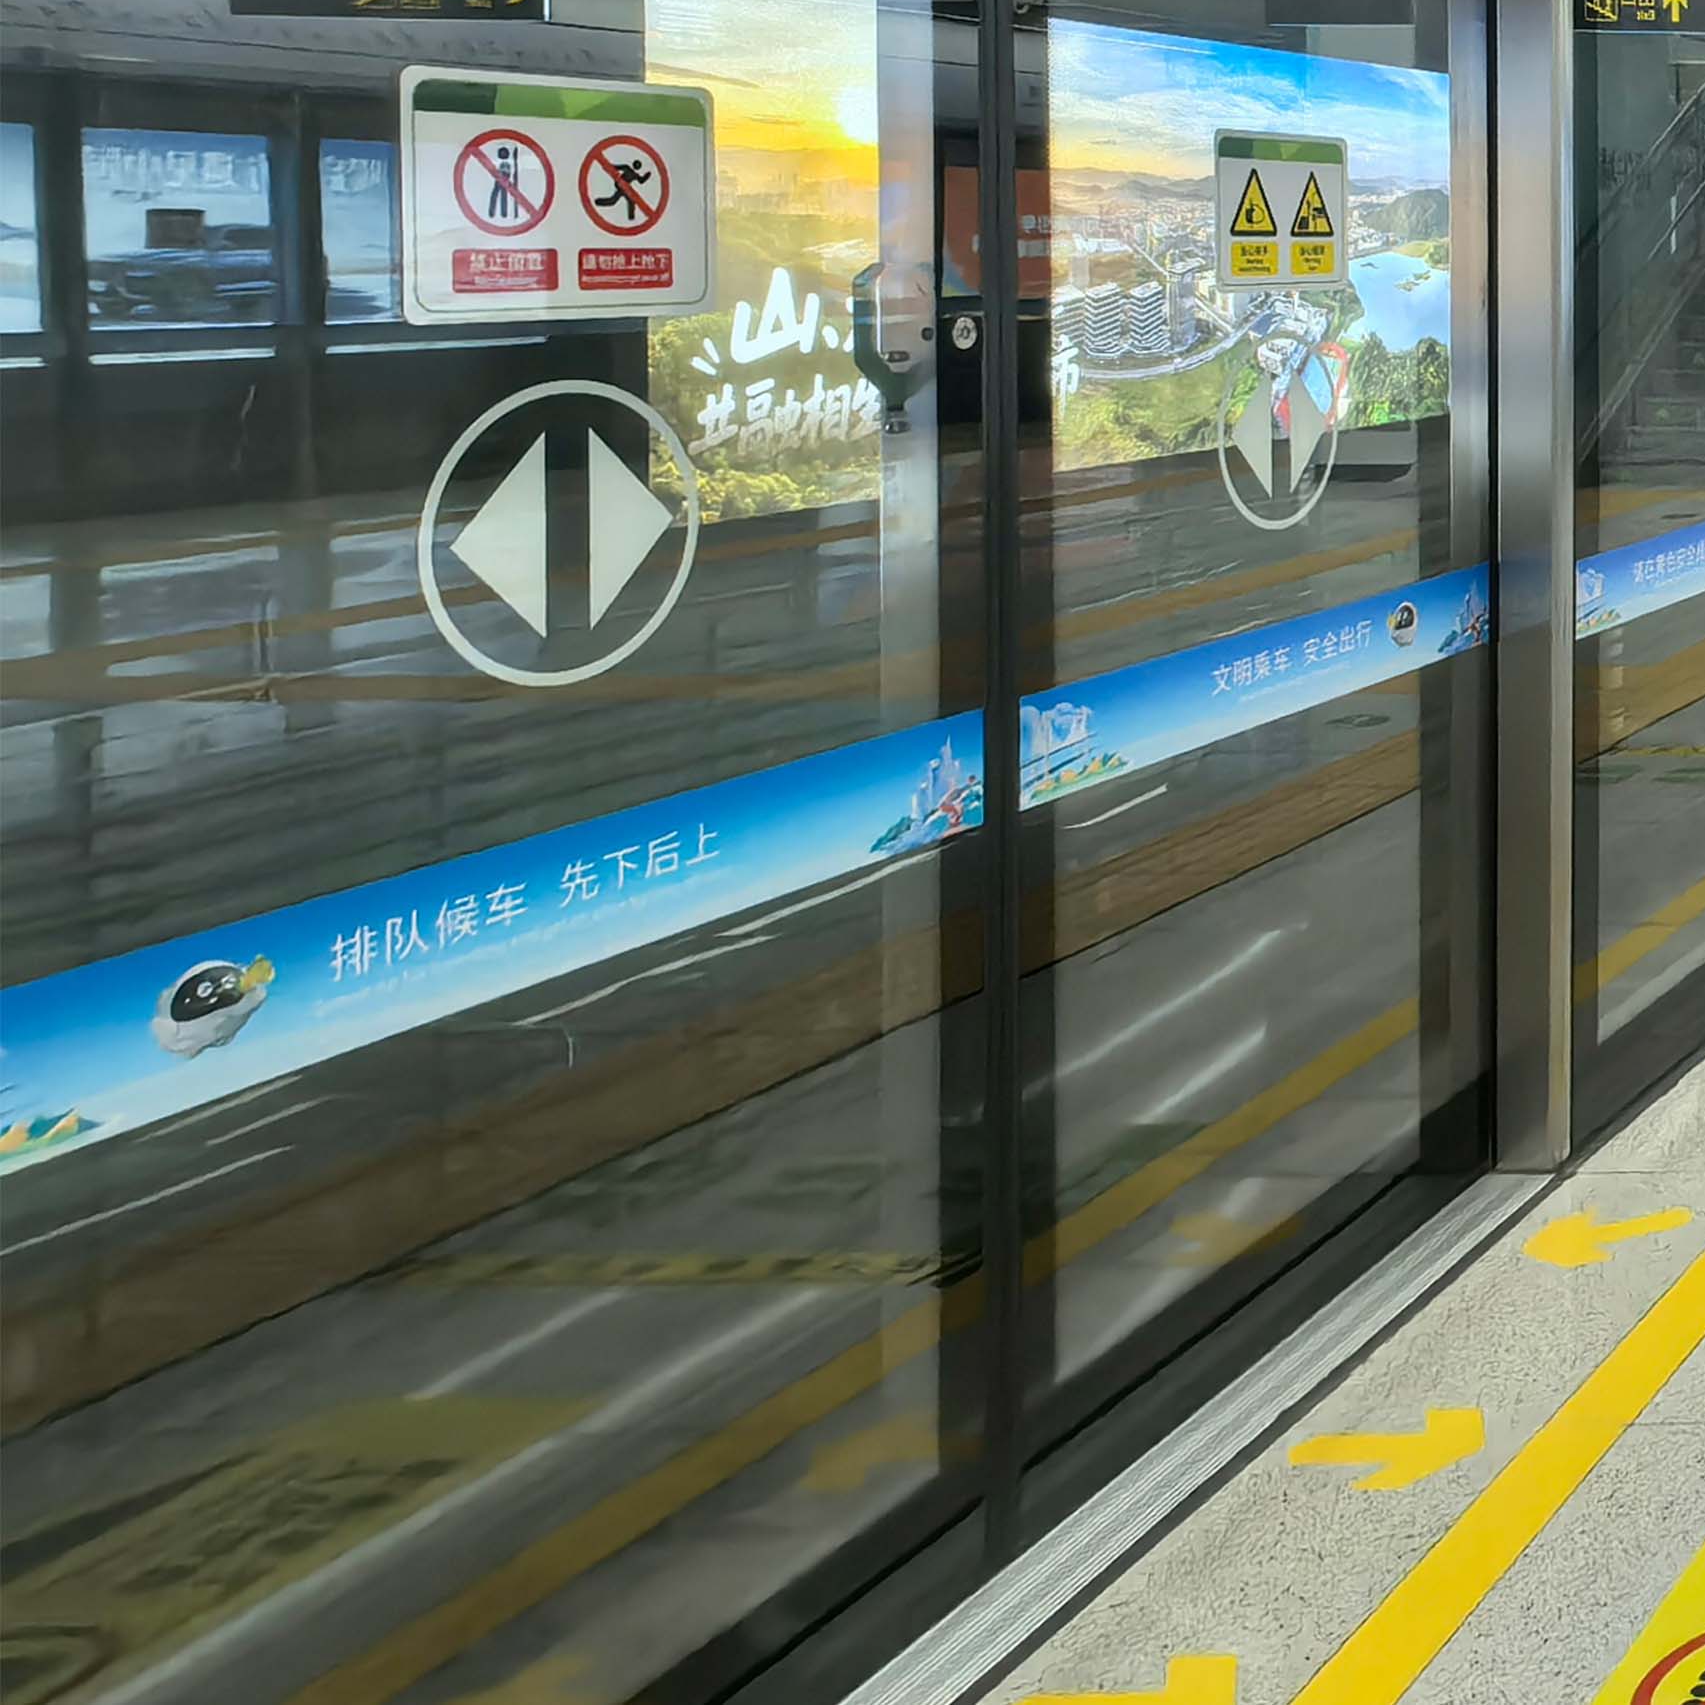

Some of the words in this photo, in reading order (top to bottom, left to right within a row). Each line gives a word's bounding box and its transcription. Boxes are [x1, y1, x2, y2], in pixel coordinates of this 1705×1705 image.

[1210, 646, 1293, 696] 文明乘车
[1303, 620, 1373, 667] 安全出行
[330, 883, 529, 982] 排队候车
[559, 823, 720, 908] 先下后上
